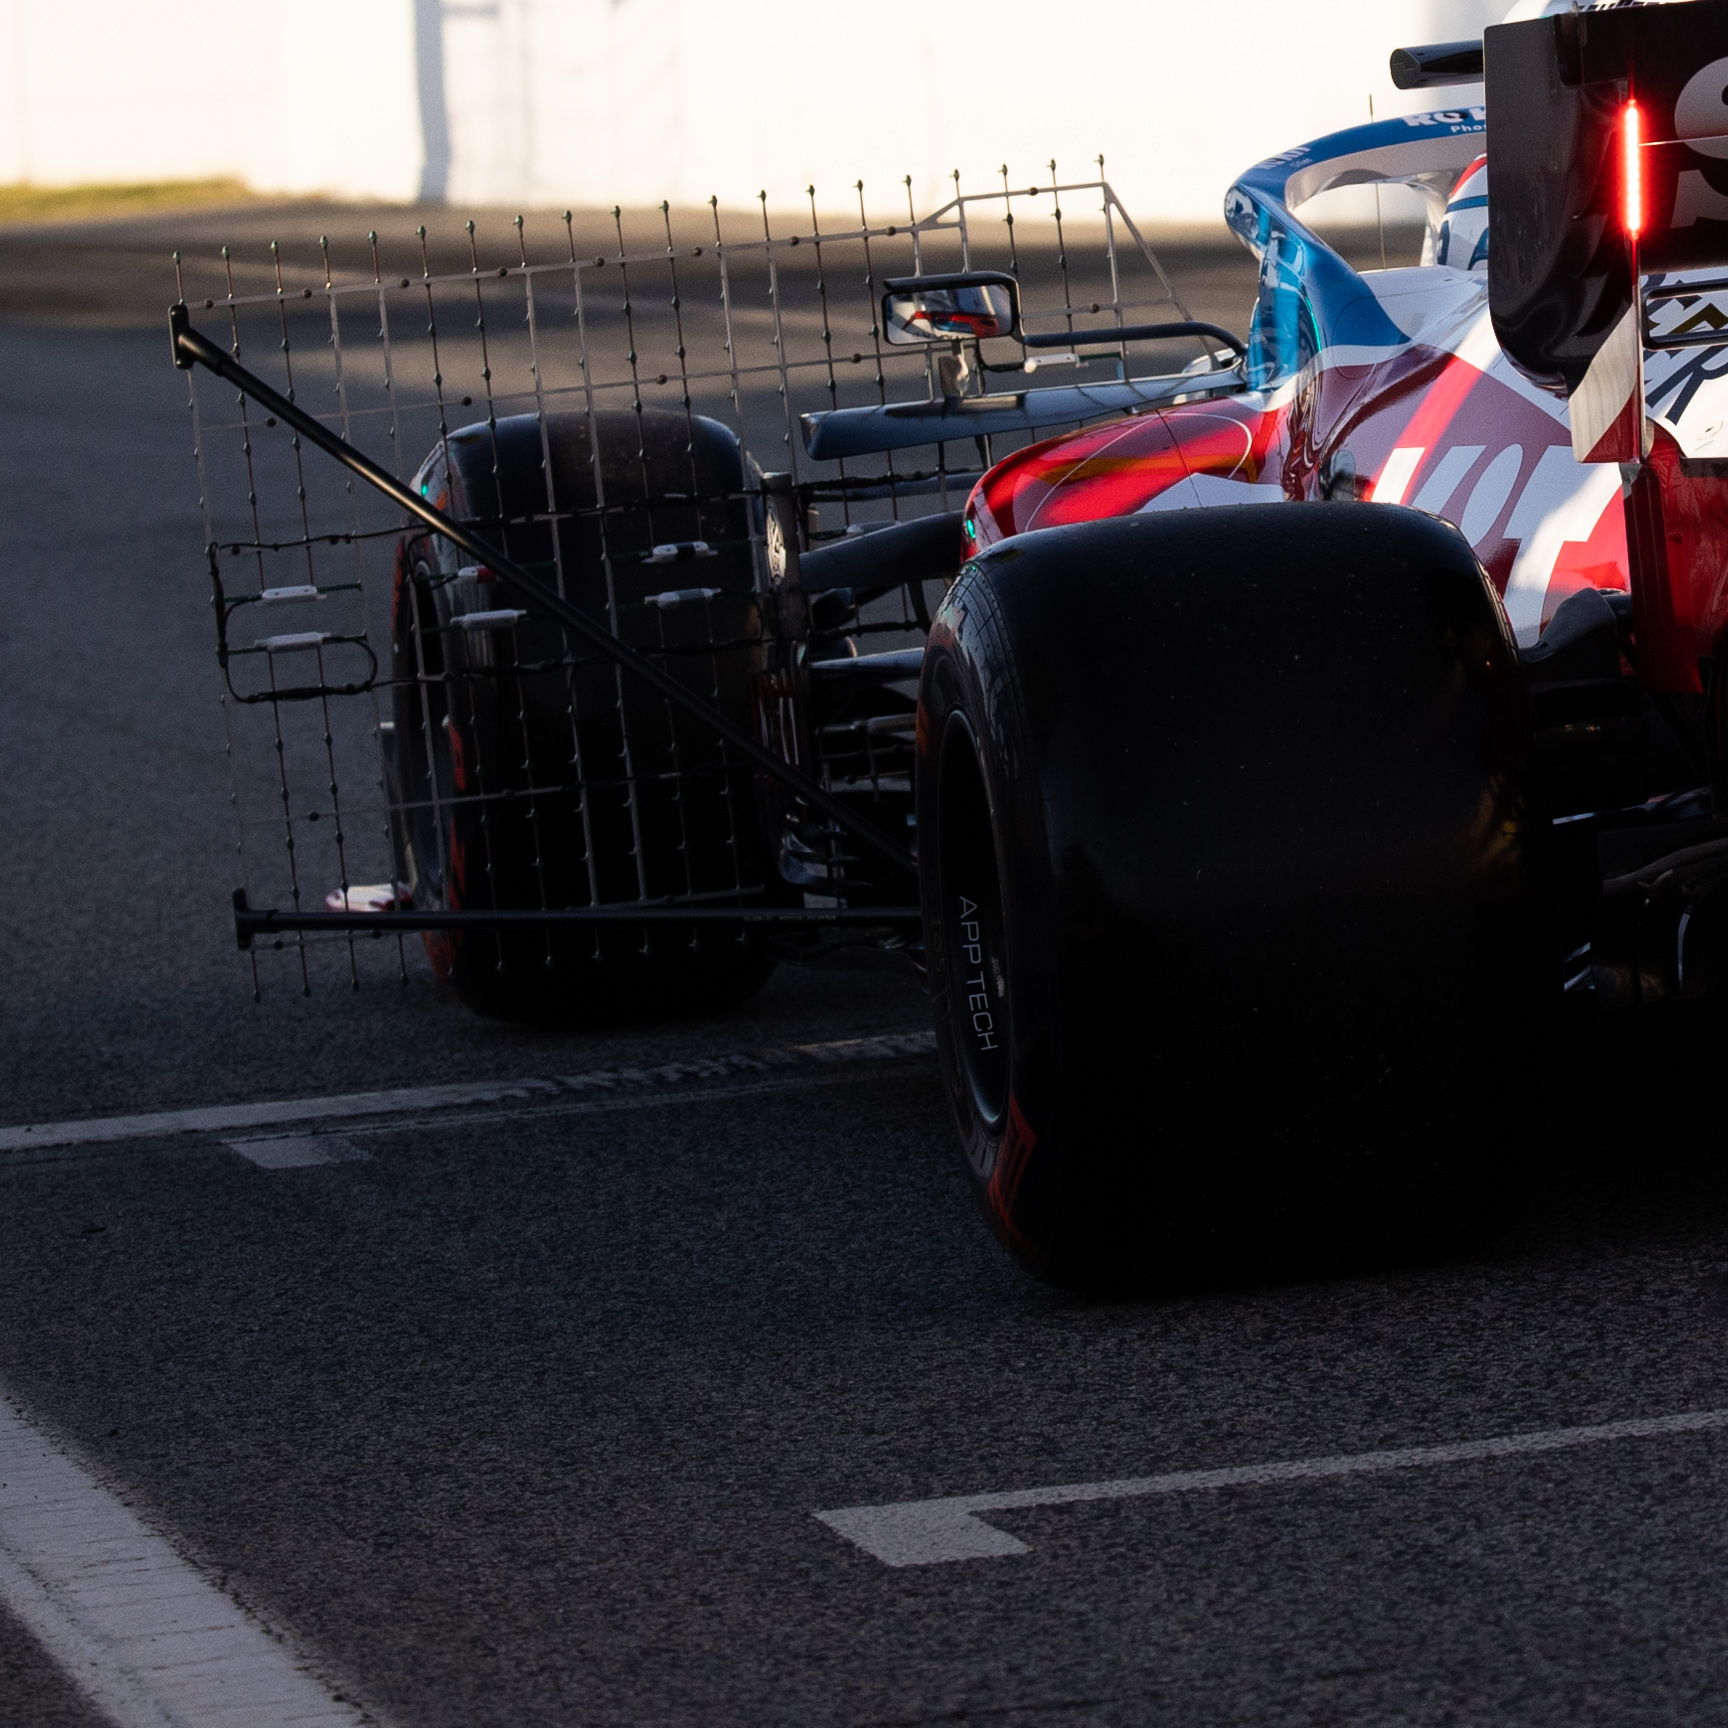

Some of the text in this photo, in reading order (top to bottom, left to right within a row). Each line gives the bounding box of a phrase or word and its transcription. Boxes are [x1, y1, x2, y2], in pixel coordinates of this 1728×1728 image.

[1450, 124, 1485, 134] Pho
[959, 895, 982, 964] APP
[966, 971, 999, 1051] TECH
